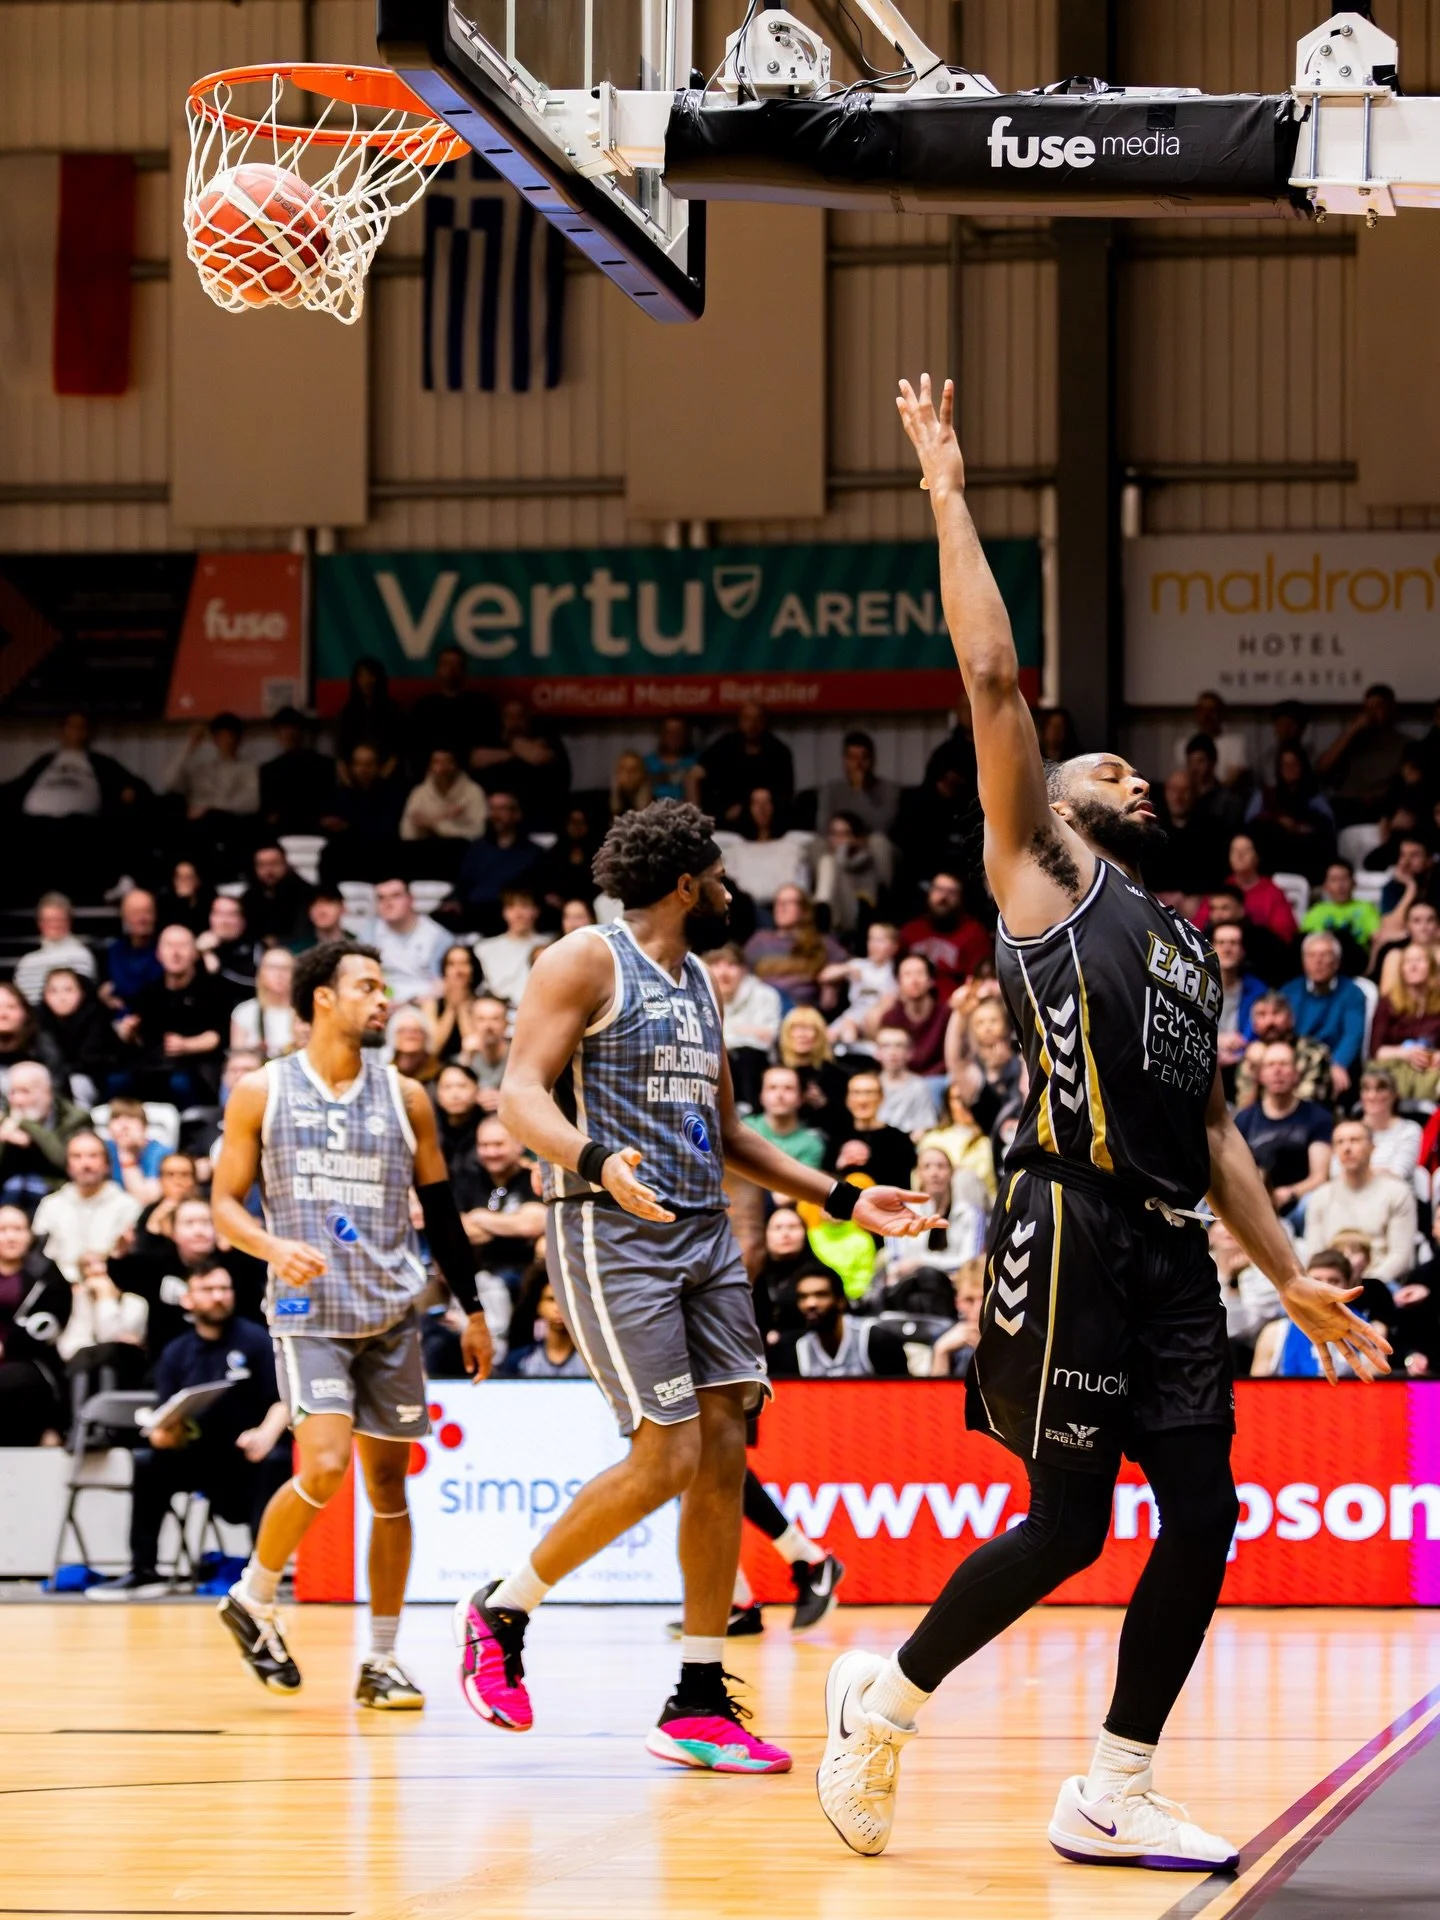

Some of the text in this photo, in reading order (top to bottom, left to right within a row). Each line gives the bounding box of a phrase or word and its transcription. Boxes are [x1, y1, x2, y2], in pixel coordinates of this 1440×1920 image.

[987, 116, 1180, 169] fuse media
[1151, 551, 1434, 614] maldron
[203, 598, 288, 641] fuse
[373, 567, 704, 660] Vertu
[1238, 632, 1345, 656] HOTEL
[531, 680, 819, 707] Official Motor Retailer
[1219, 669, 1363, 687] NEWCASTLE
[670, 997, 703, 1044] 56
[327, 1110, 347, 1149] 5
[1045, 1432, 1094, 1448] EAGLES
